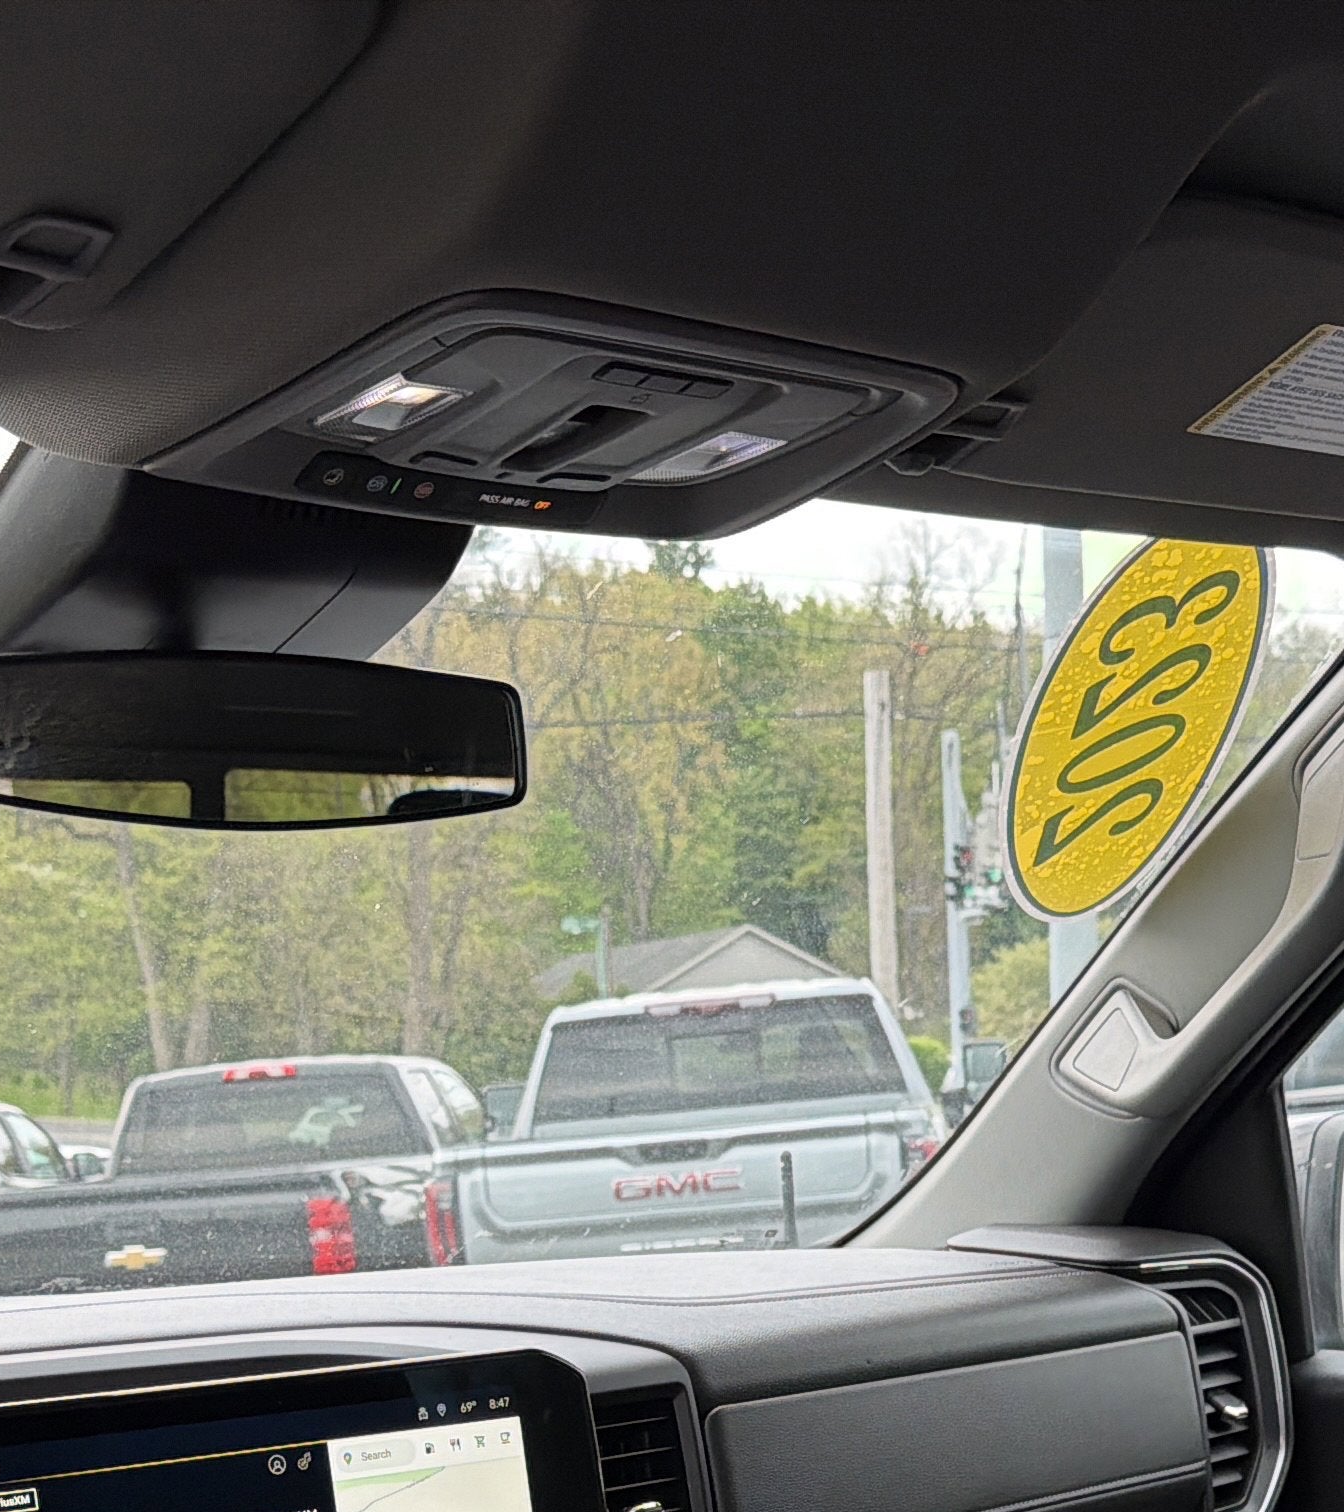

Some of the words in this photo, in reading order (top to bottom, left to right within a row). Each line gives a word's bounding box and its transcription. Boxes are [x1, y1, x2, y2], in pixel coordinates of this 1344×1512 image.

[479, 493, 499, 503] PASS
[500, 495, 514, 505] AIR
[513, 497, 530, 508] BAG
[534, 500, 551, 510] OFF
[613, 1168, 742, 1201] GMC
[489, 1396, 510, 1410] 8:47
[361, 1448, 392, 1463] Search
